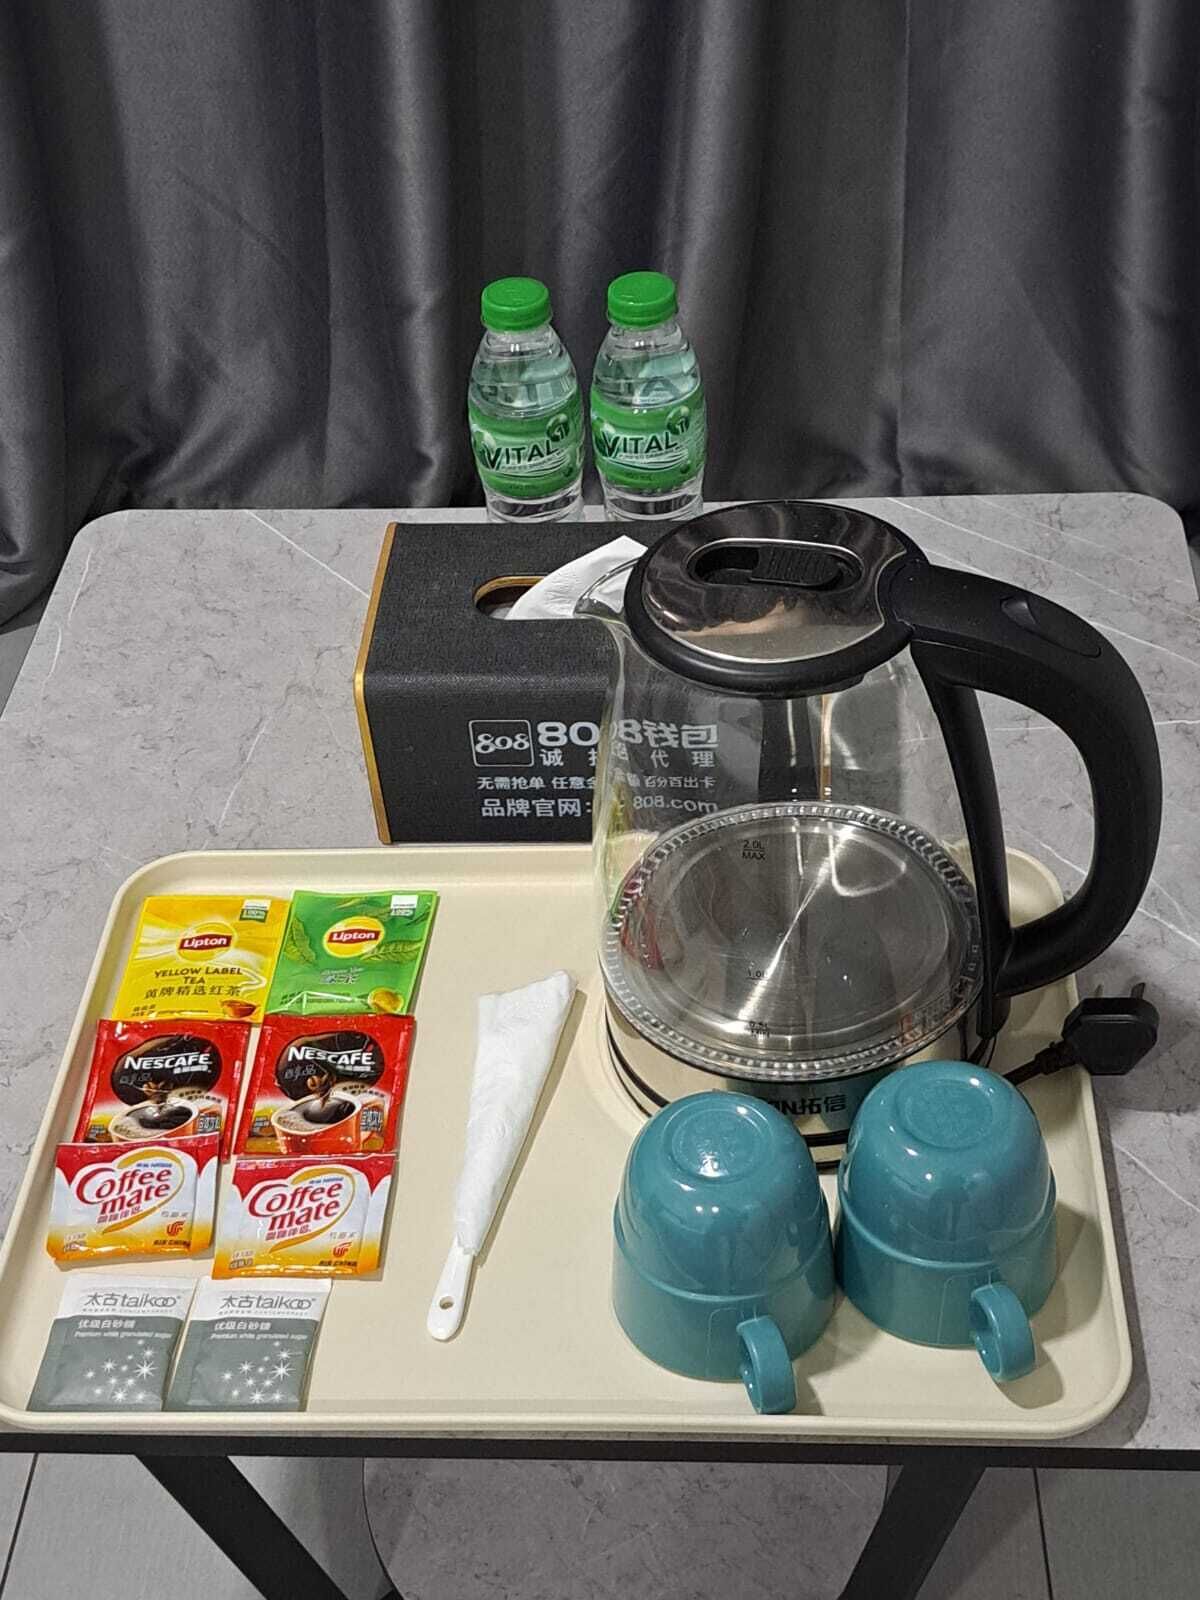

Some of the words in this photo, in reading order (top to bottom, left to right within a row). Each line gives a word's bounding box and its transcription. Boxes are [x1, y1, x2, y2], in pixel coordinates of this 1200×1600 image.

[482, 439, 559, 471] VITAL
[601, 431, 678, 459] VITAL
[475, 733, 530, 754] 808
[183, 937, 227, 949] Lipton
[332, 931, 376, 942] Lipton
[154, 967, 202, 978] YELLOW
[205, 966, 243, 976] LABEL
[183, 976, 206, 985] TEA
[76, 1168, 172, 1205] Coffee
[100, 1184, 171, 1215] mate
[248, 1183, 343, 1217] Coffee
[268, 1200, 341, 1231] mate
